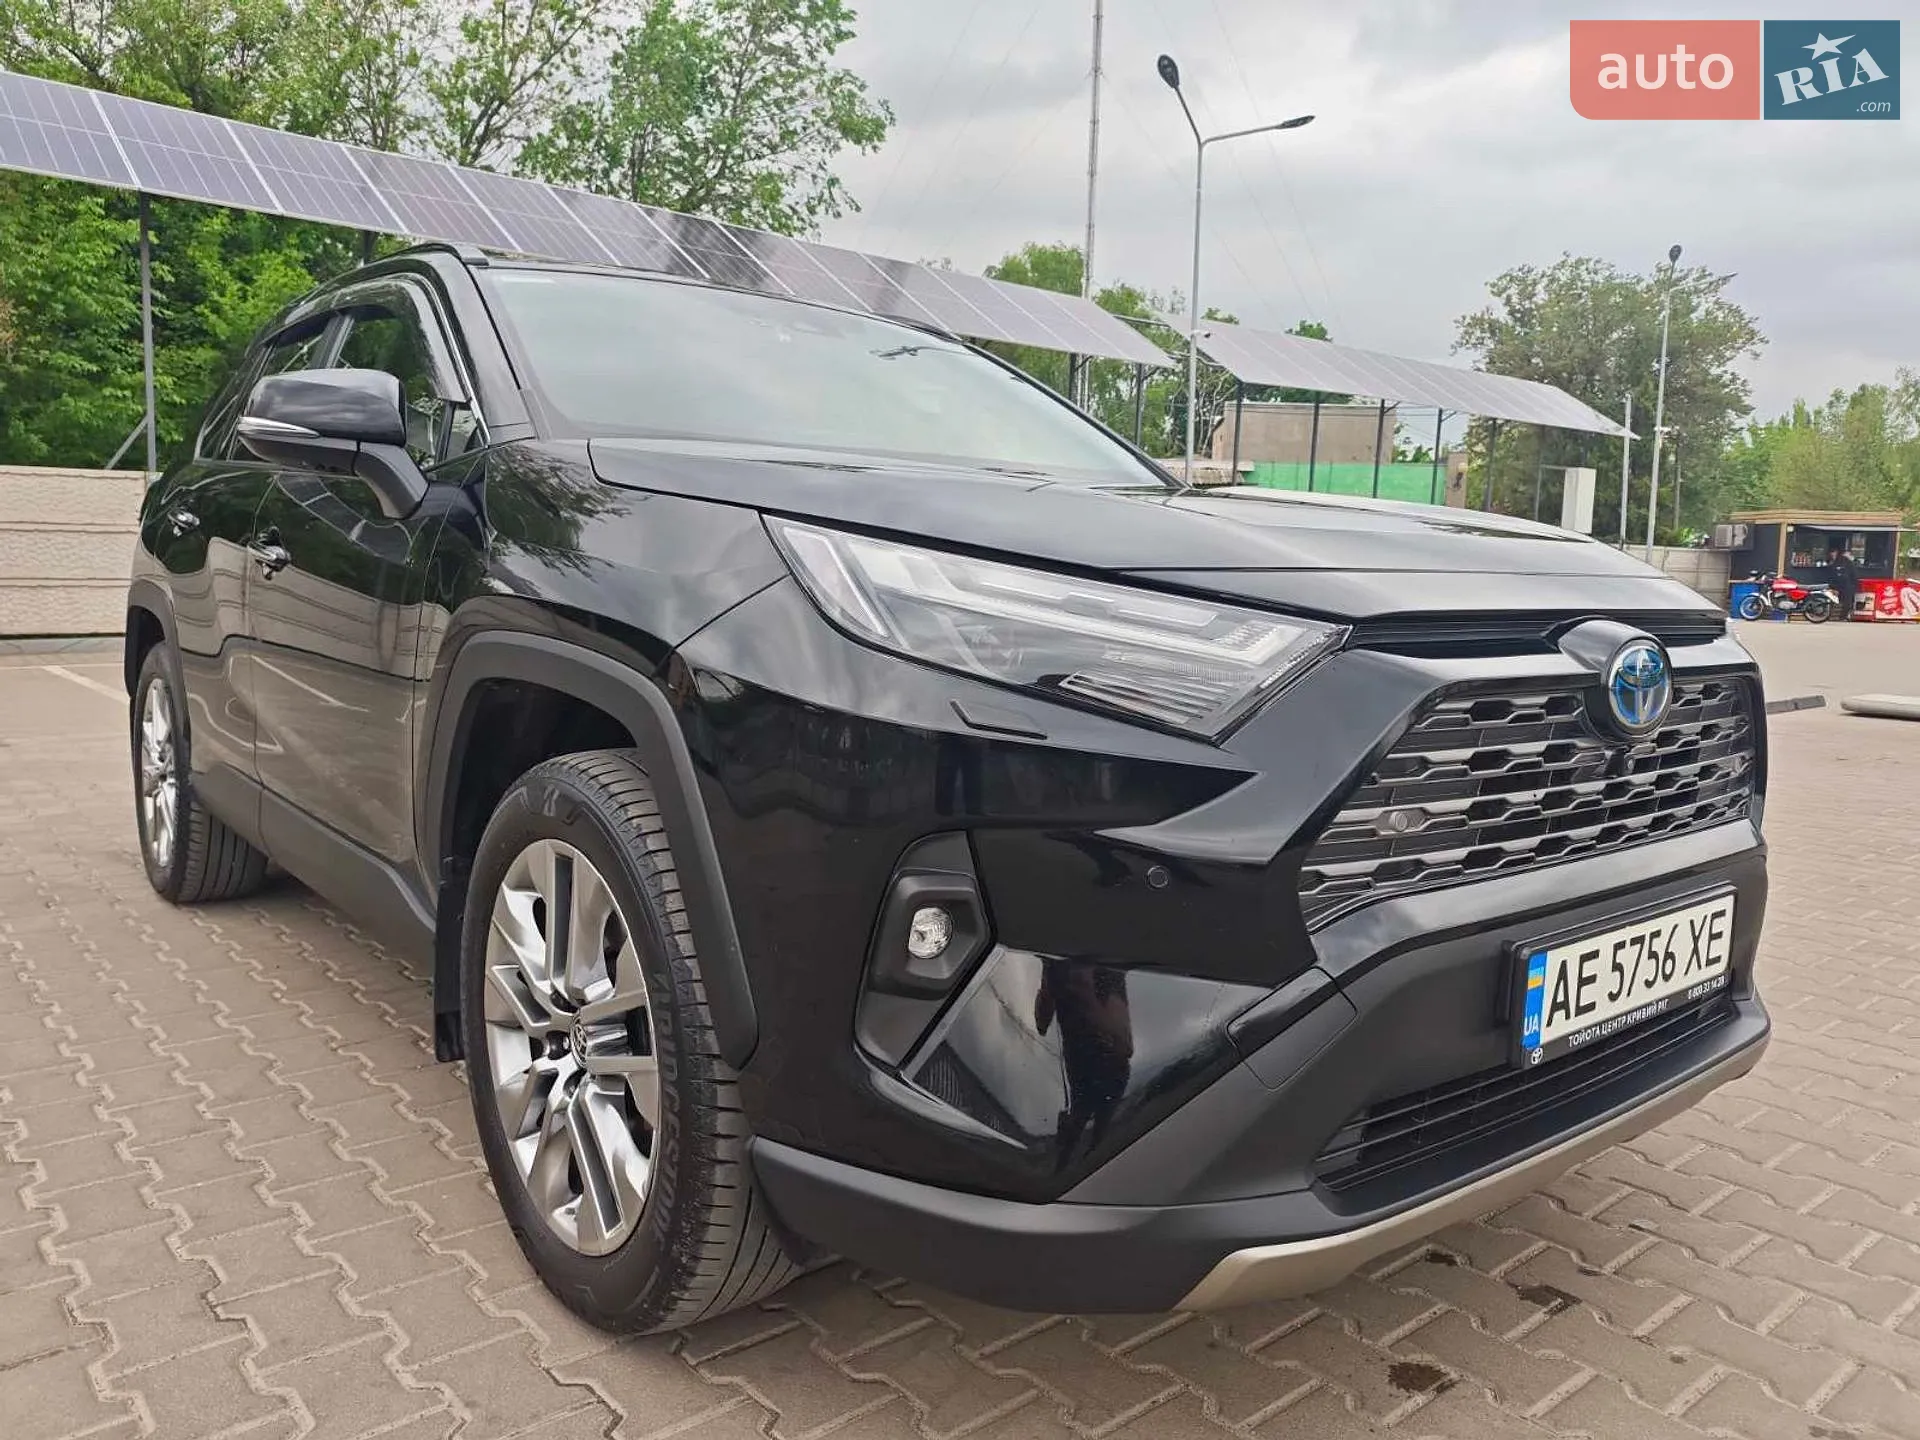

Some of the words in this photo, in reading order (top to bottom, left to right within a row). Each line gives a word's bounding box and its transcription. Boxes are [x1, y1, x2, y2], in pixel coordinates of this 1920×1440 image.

[1546, 948, 1600, 1028] AE
[1607, 923, 1679, 1002] 5756
[1684, 909, 1727, 977] XE
[1523, 1015, 1539, 1036] UA
[1568, 1025, 1600, 1048] ТОЙОТА
[1601, 1015, 1626, 1035] ЦЕНТР
